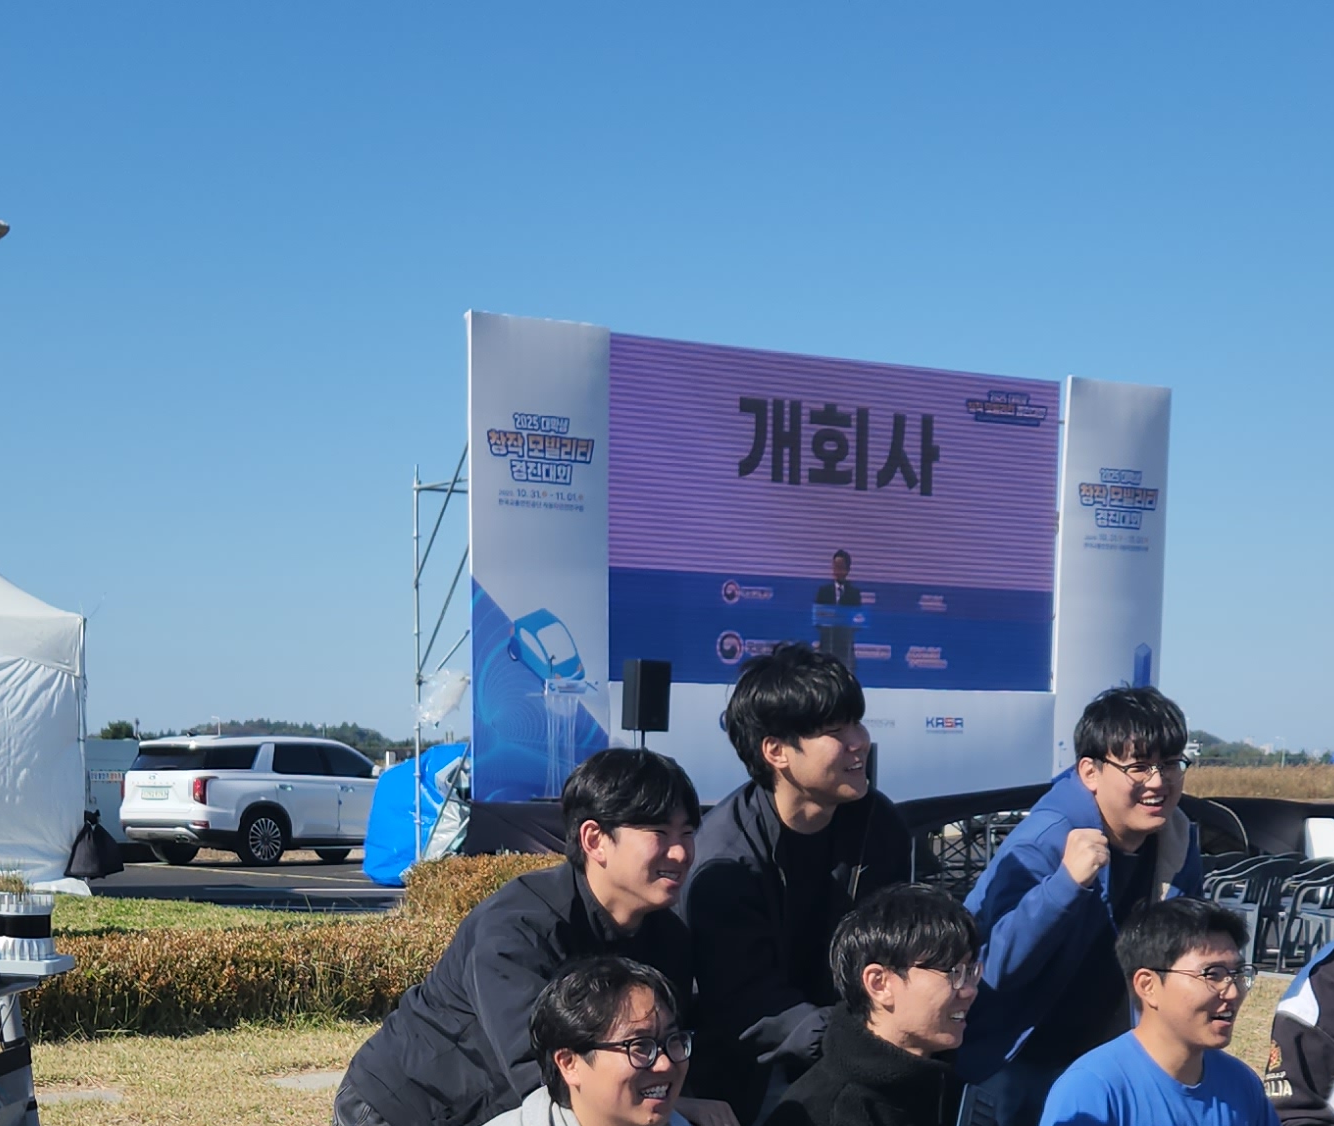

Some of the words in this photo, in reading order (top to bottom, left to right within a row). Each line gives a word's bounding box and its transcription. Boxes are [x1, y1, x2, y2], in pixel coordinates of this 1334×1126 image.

[514, 413, 540, 430] 2025
[541, 417, 569, 434] 대학생
[488, 429, 525, 457] 창작
[527, 434, 594, 463] 모빌리티
[738, 397, 940, 496] 개회사
[511, 460, 572, 485] 경진대회
[1079, 483, 1108, 507] 창작
[1110, 486, 1158, 510] 모빌리티
[1095, 508, 1142, 530] 경진대회
[926, 717, 964, 728] KASA
